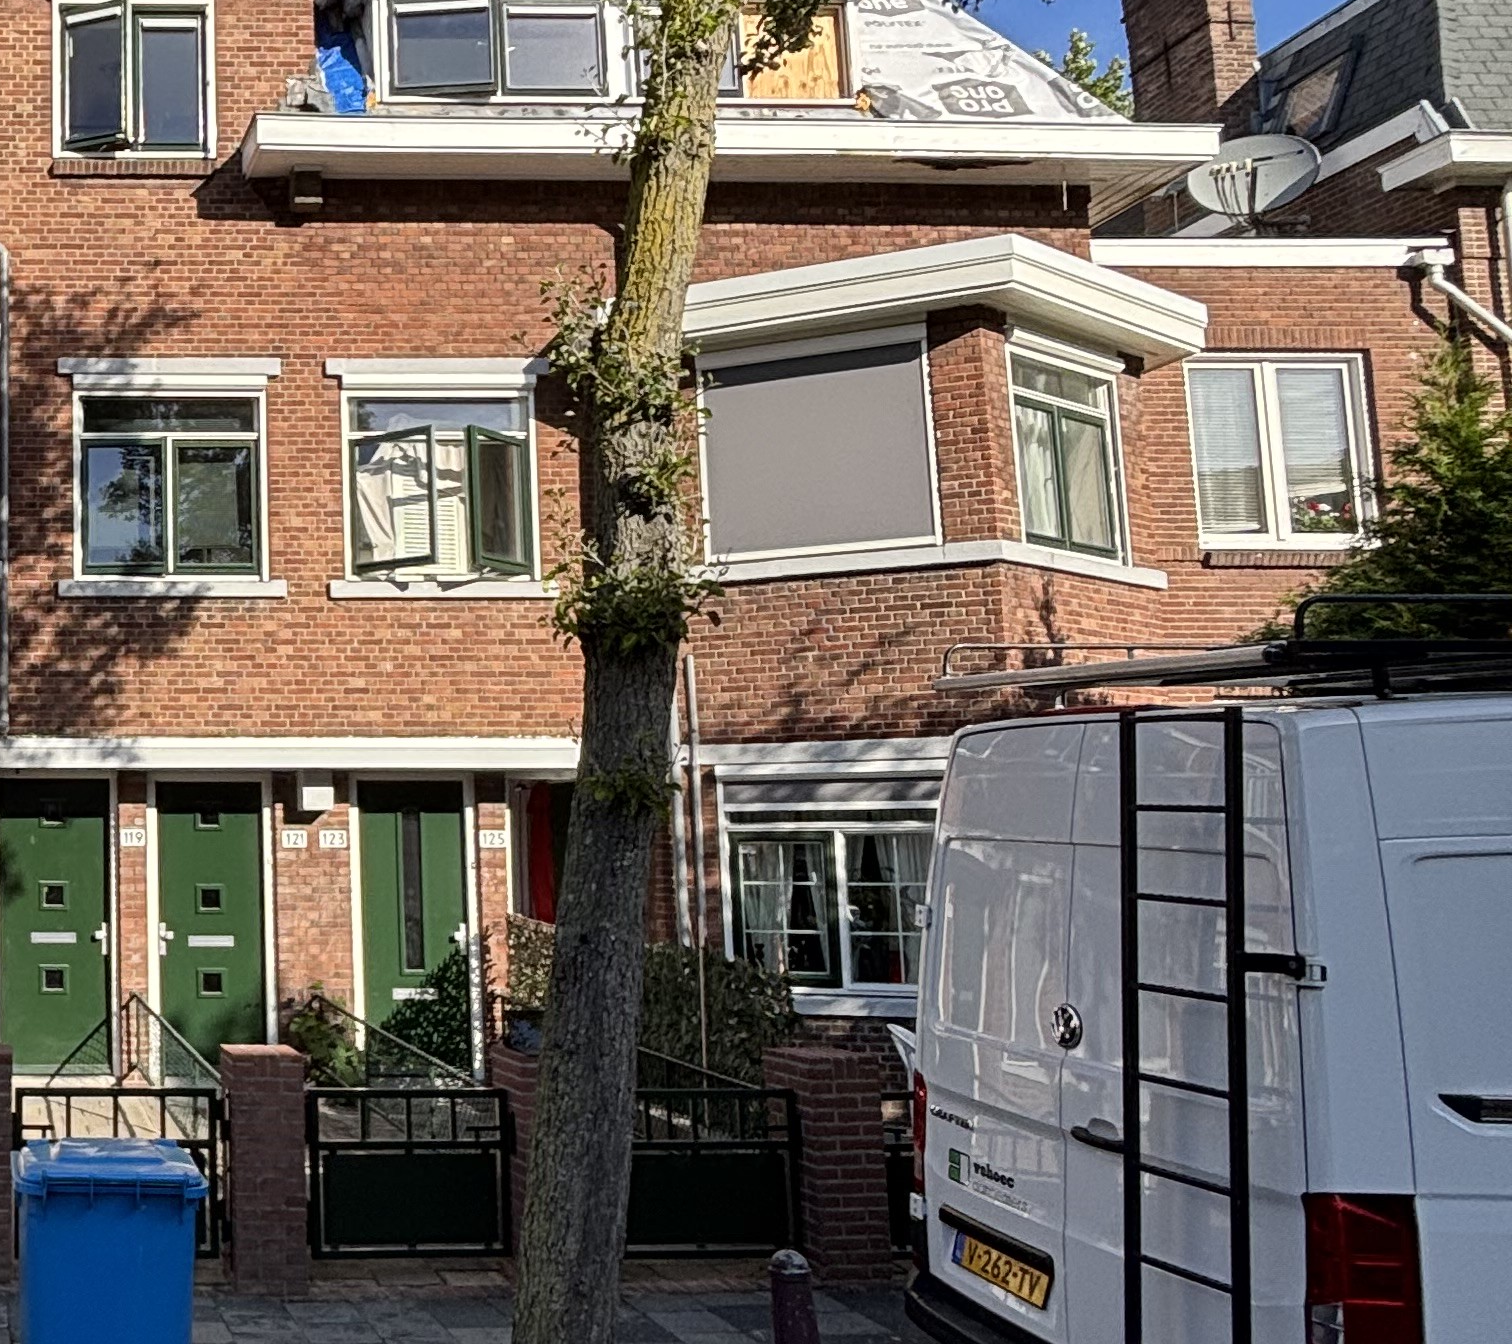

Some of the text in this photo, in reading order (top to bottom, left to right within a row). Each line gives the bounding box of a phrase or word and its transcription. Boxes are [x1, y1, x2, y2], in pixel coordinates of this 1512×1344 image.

[124, 831, 144, 844] 119
[286, 833, 304, 845] 121
[322, 833, 345, 845] 123
[482, 832, 505, 846] 125
[968, 1240, 1042, 1299] V-262-TV
